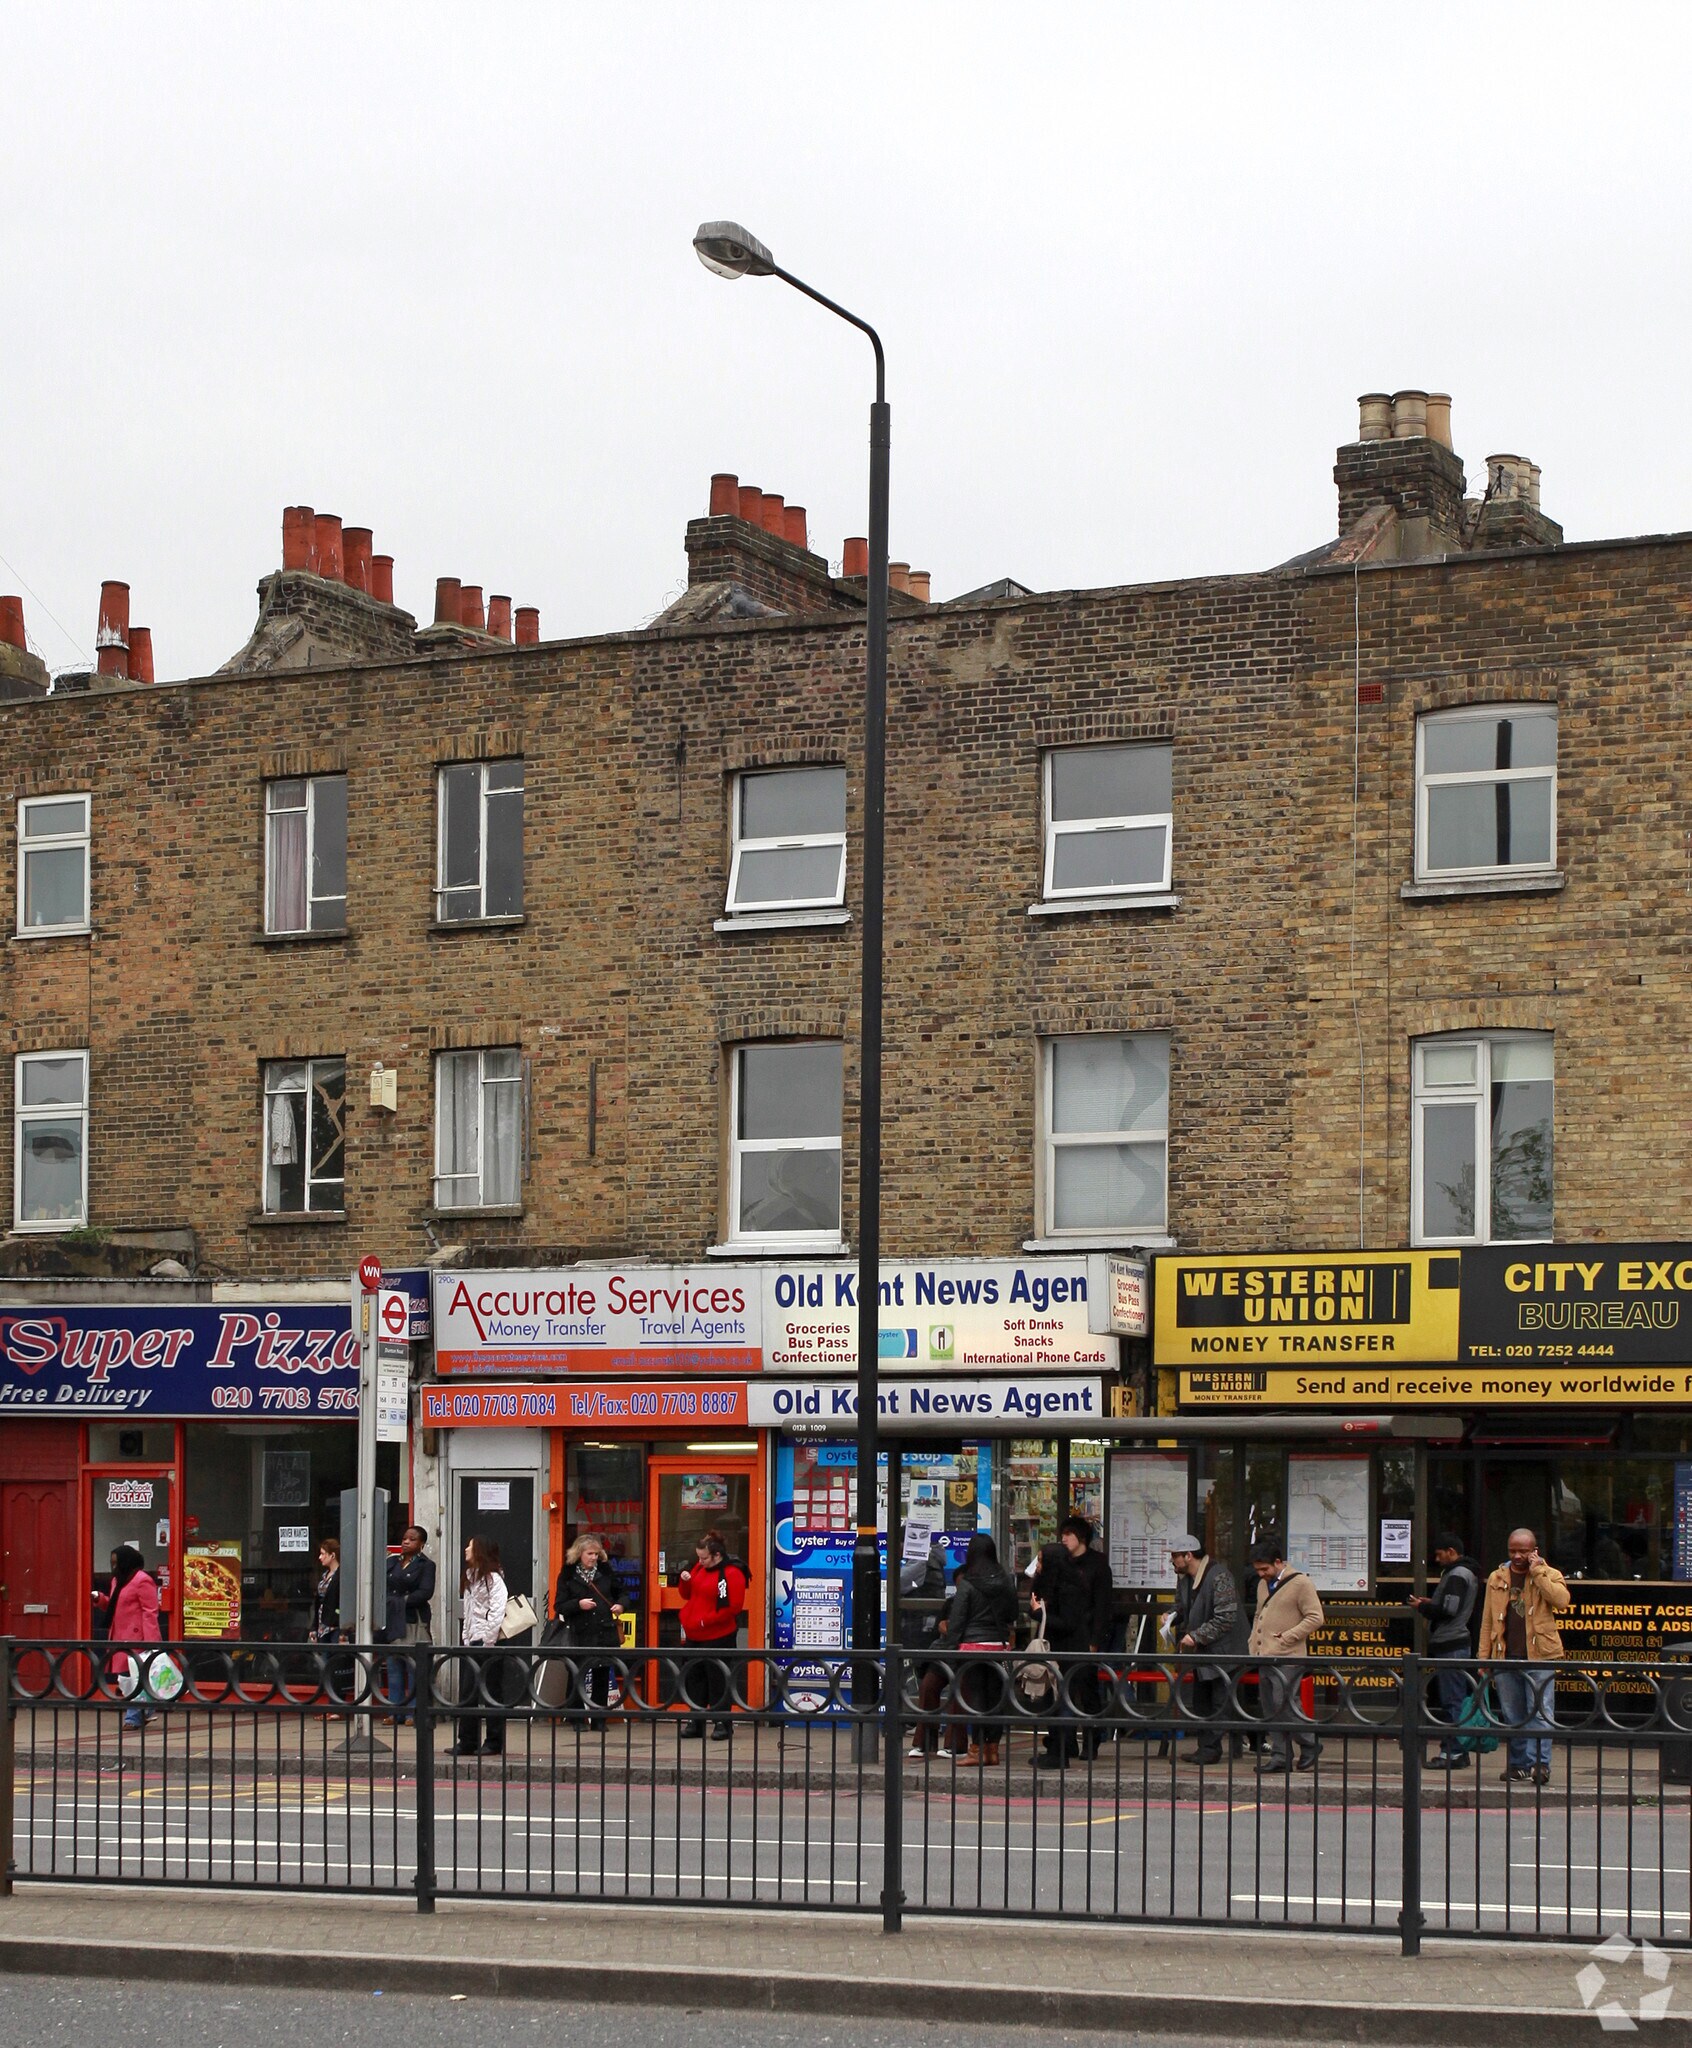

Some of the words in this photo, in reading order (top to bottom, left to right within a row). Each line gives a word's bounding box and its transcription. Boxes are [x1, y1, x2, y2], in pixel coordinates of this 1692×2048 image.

[364, 1265, 380, 1278] WN
[1504, 1263, 1604, 1293] CITY
[1618, 1261, 1692, 1291] EXC
[1117, 1278, 1140, 1293] Groceries
[1183, 1269, 1364, 1296] WESTERN
[775, 1274, 823, 1308] Old
[835, 1273, 904, 1307] Knt
[915, 1272, 999, 1305] News
[1009, 1269, 1088, 1312] Agen
[1118, 1293, 1127, 1304] Bus
[1128, 1294, 1140, 1306] Pass
[448, 1280, 596, 1341] Accurate
[607, 1276, 746, 1314] Services
[1113, 1305, 1146, 1324] Confectionery
[1244, 1296, 1364, 1322] UNION
[1518, 1301, 1679, 1330] BUREAU
[488, 1320, 540, 1341] Money
[545, 1317, 606, 1336] Transfer
[639, 1315, 685, 1334] Travel
[691, 1317, 745, 1339] Agents
[786, 1322, 850, 1334] Groceries
[1003, 1319, 1025, 1331] Soft
[1029, 1319, 1064, 1331] Drinks
[788, 1337, 813, 1349] Bus
[817, 1337, 848, 1348] Pass
[1014, 1334, 1054, 1346] Snacks
[1191, 1336, 1269, 1353] MONEY
[1279, 1335, 1395, 1352] TRANSFER
[7, 1320, 195, 1383] Super
[206, 1312, 360, 1374] Pizza
[1469, 1345, 1502, 1357] TEL:
[1506, 1345, 1532, 1357] 020
[1537, 1345, 1573, 1357] 7252
[1577, 1345, 1614, 1356] 4444
[772, 1351, 857, 1363] Confectioner
[963, 1352, 1033, 1364] International
[1036, 1352, 1070, 1363] Phone
[1074, 1351, 1106, 1363] Cards
[1192, 1373, 1252, 1382] WESTERN
[1212, 1381, 1252, 1391] UNION
[1296, 1377, 1345, 1394] Send
[1352, 1377, 1390, 1394] and
[1396, 1377, 1472, 1393] receive
[1482, 1380, 1552, 1397] money
[1560, 1375, 1675, 1393] worldwide
[1685, 1376, 1692, 1392] f
[0, 1384, 48, 1403] Free
[55, 1384, 152, 1407] Delivery
[212, 1386, 253, 1408] 020
[259, 1387, 311, 1409] 7703
[773, 1389, 820, 1414] Old
[832, 1388, 899, 1414] Knt
[911, 1388, 992, 1413] News
[1003, 1386, 1092, 1418] Agent
[427, 1394, 452, 1417] Tel:
[454, 1395, 480, 1417] 020
[483, 1394, 517, 1416] 7703
[521, 1393, 556, 1416] 7084
[570, 1391, 628, 1417] Tel/Fax:
[631, 1393, 658, 1415] 020
[662, 1392, 697, 1415] 7703
[702, 1392, 738, 1415] 8887
[826, 1450, 857, 1462] oyste
[134, 1483, 151, 1491] cook
[109, 1492, 131, 1503] JUST
[133, 1492, 151, 1503] EAT
[794, 1536, 828, 1547] oyster
[835, 1539, 847, 1547] Buy
[826, 1553, 853, 1566] oyst
[797, 1592, 840, 1600] UNLIMITED
[1552, 1605, 1576, 1615] AST
[1581, 1605, 1652, 1616] INTERNET
[1655, 1605, 1692, 1616] ACCE
[1557, 1620, 1642, 1631] BROADBAND
[1647, 1620, 1657, 1631] &
[1661, 1621, 1692, 1632] ADS
[1309, 1631, 1335, 1641] BUY
[1339, 1631, 1349, 1641] &
[1353, 1631, 1386, 1642] SELL
[1589, 1635, 1598, 1646] 1
[1602, 1635, 1643, 1647] HOUR
[1309, 1646, 1343, 1656] LERS
[1346, 1646, 1411, 1657] CHEQUES
[1563, 1651, 1614, 1663] NIMUM
[1617, 1651, 1660, 1663] CHAR
